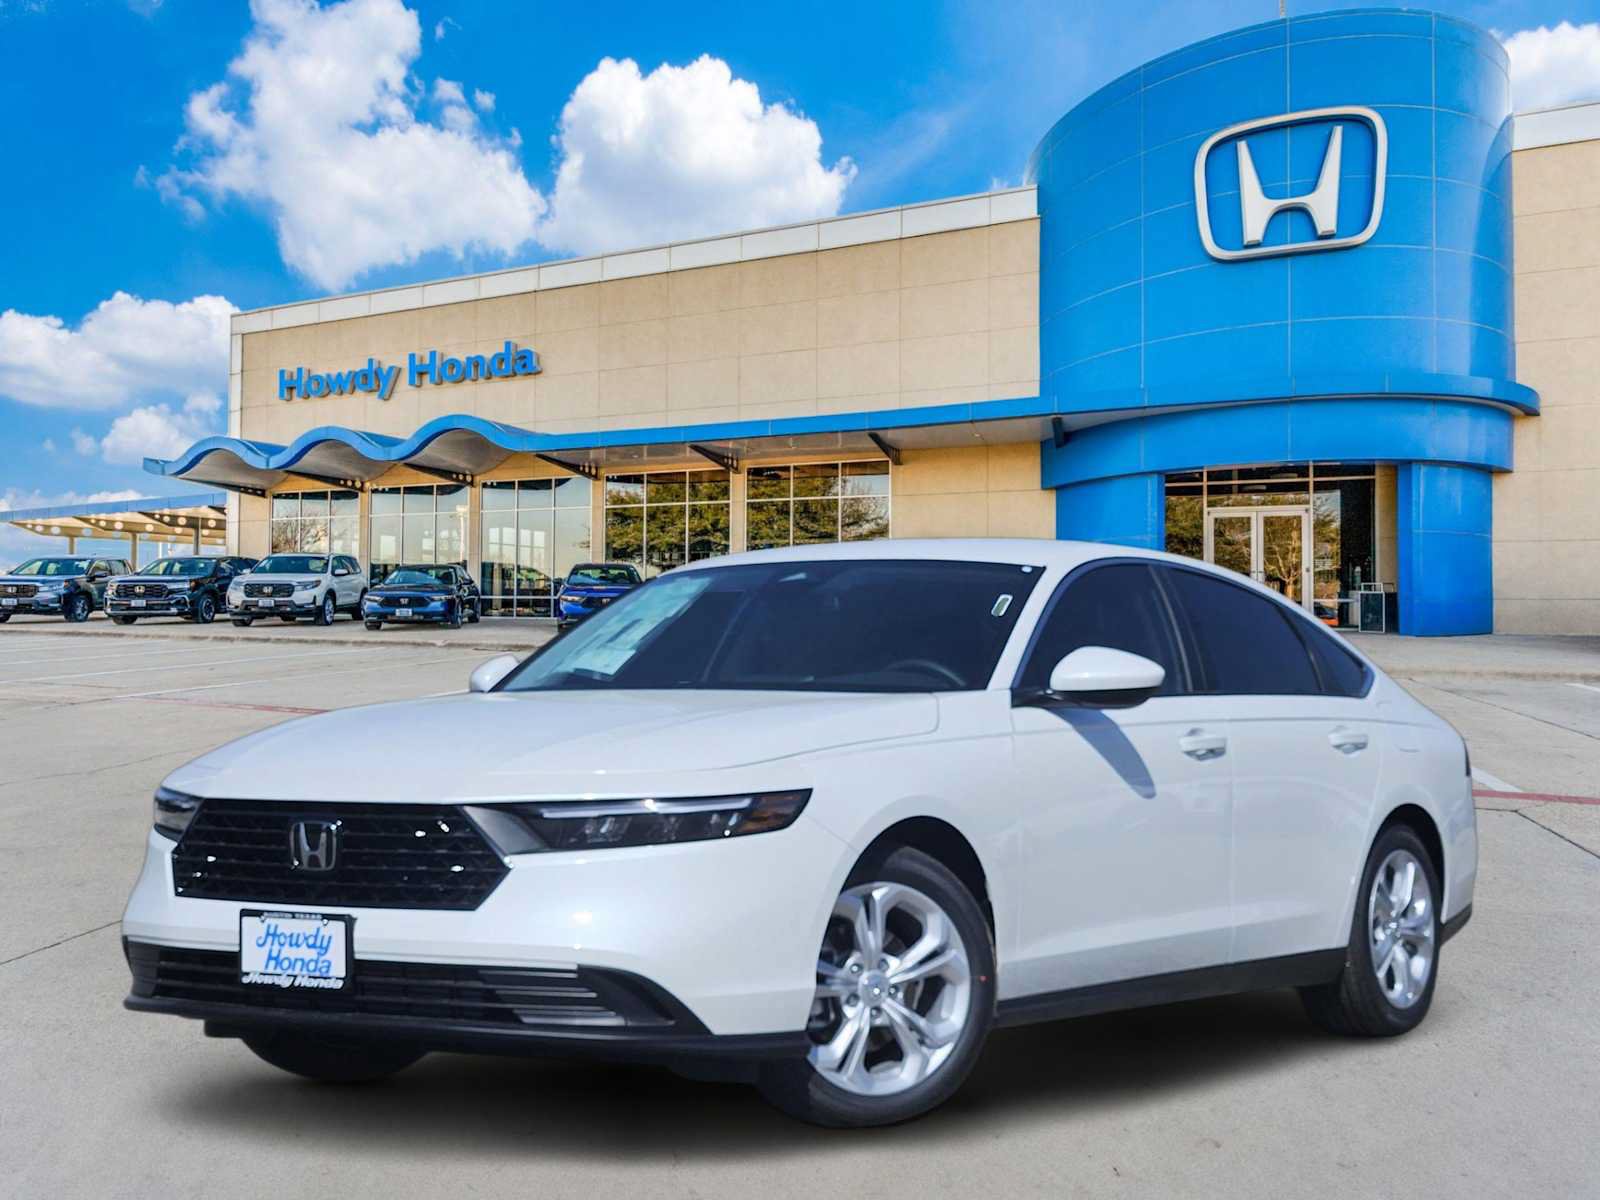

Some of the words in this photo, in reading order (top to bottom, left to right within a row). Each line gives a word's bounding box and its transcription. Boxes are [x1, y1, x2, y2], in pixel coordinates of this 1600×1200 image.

[278, 358, 399, 401] Howdy
[408, 341, 541, 388] Honda
[256, 924, 332, 956] Howdy
[265, 947, 332, 974] Honda
[241, 973, 293, 988] Howdy
[294, 976, 344, 989] Honda
